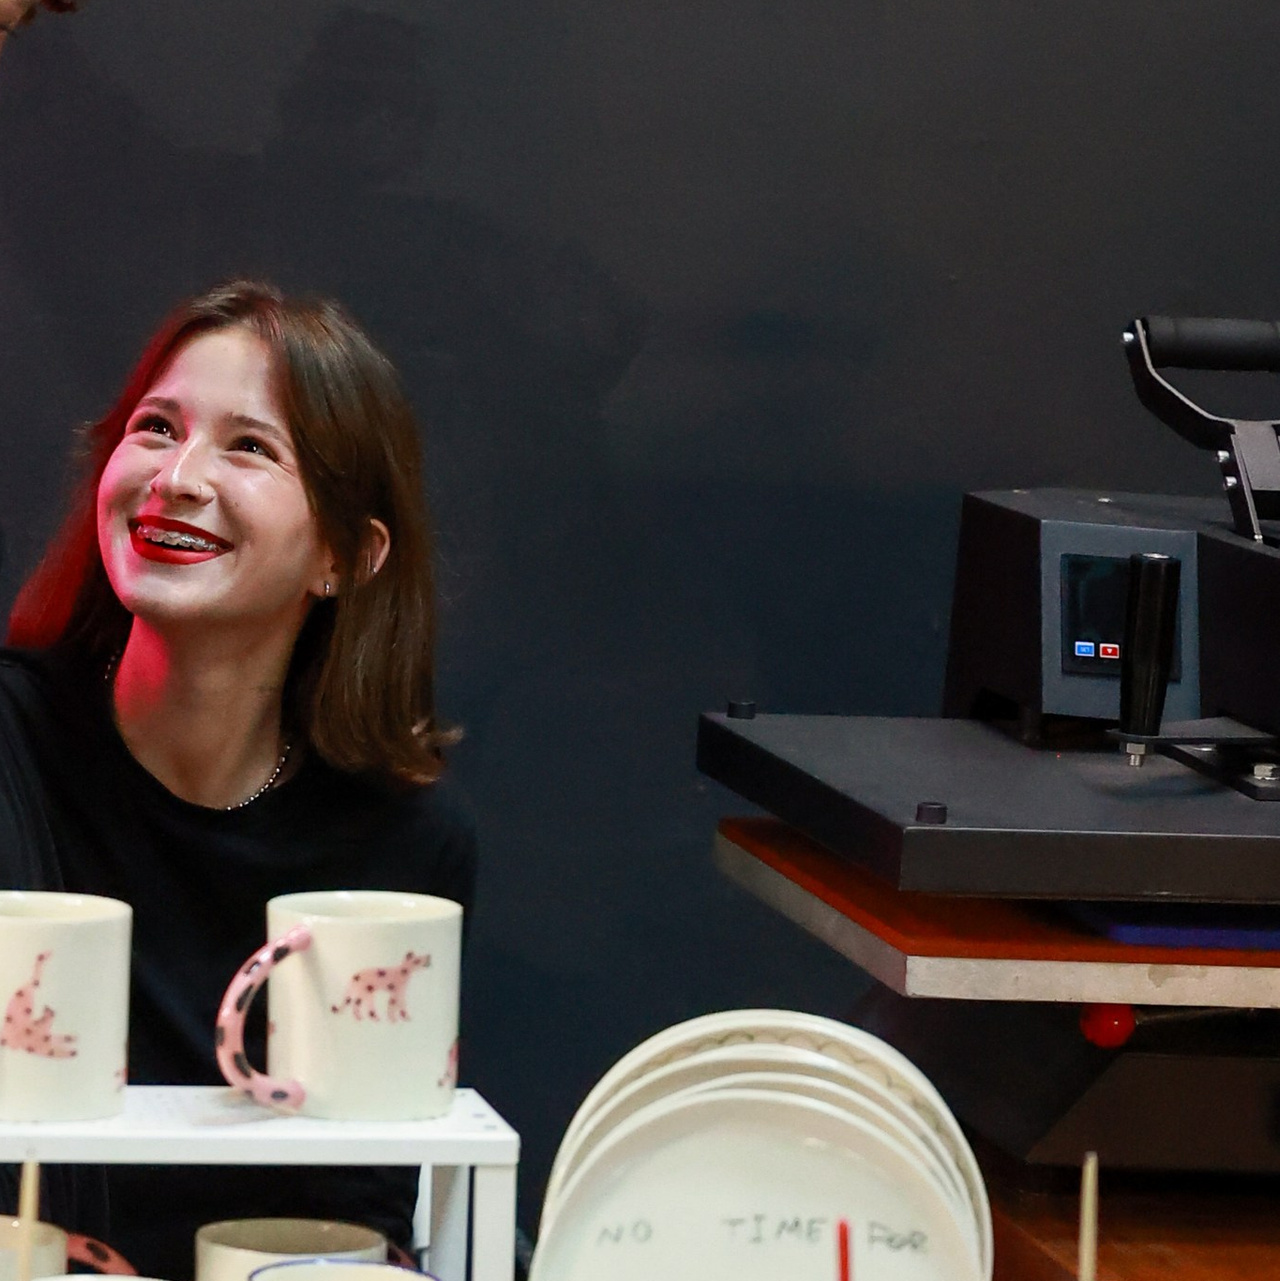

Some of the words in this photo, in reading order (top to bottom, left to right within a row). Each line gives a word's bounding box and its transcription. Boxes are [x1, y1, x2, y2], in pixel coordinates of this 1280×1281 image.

[597, 1221, 653, 1247] NO
[722, 1214, 828, 1245] TIME
[867, 1221, 929, 1253] FOR
